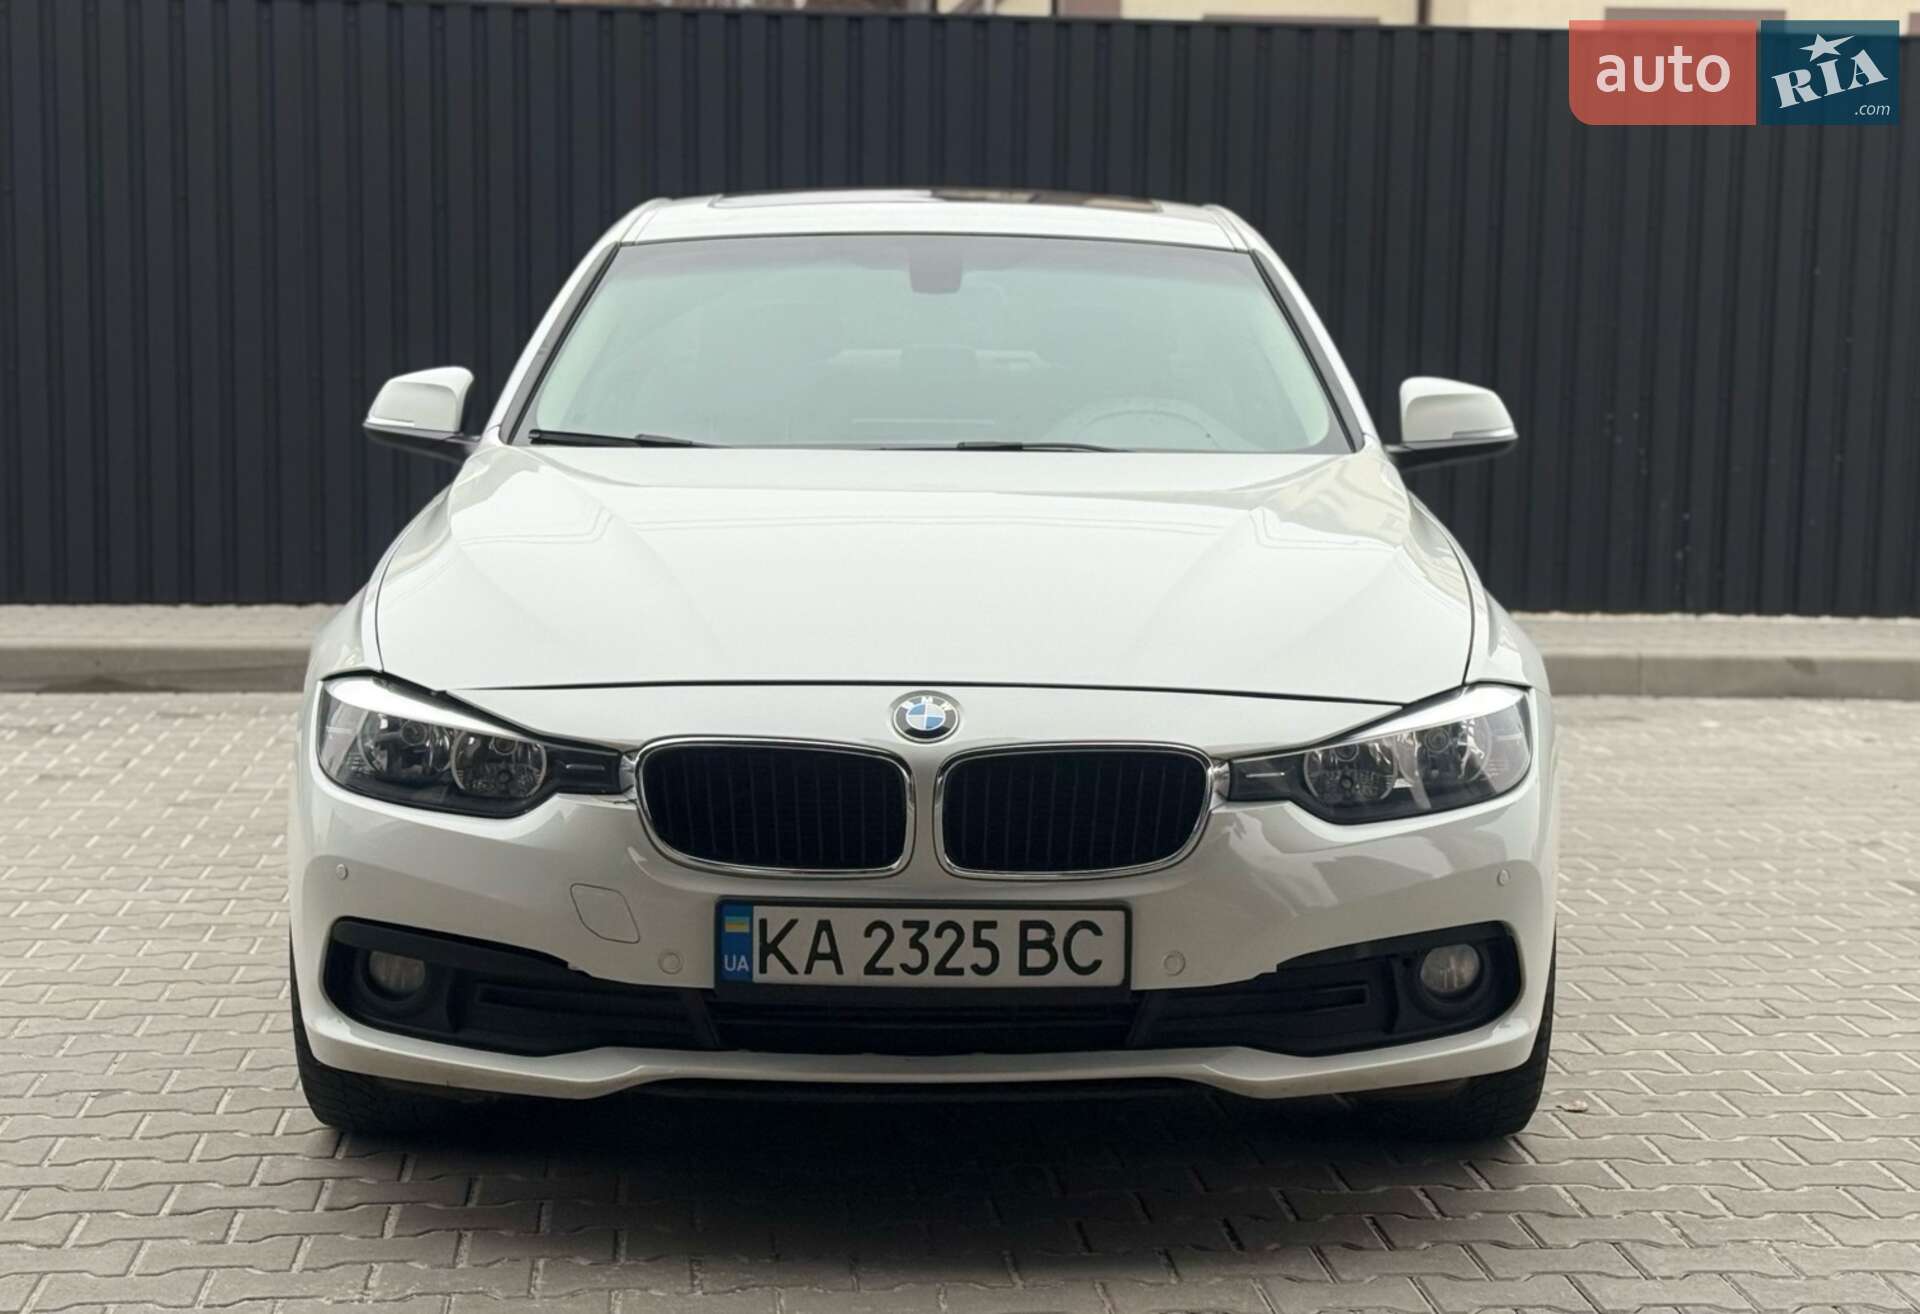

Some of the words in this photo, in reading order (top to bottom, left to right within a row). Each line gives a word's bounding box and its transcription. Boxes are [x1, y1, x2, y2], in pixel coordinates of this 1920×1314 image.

[723, 953, 750, 972] UA
[758, 917, 844, 976] KA
[863, 919, 1000, 977] 2325
[1018, 919, 1103, 976] BC
